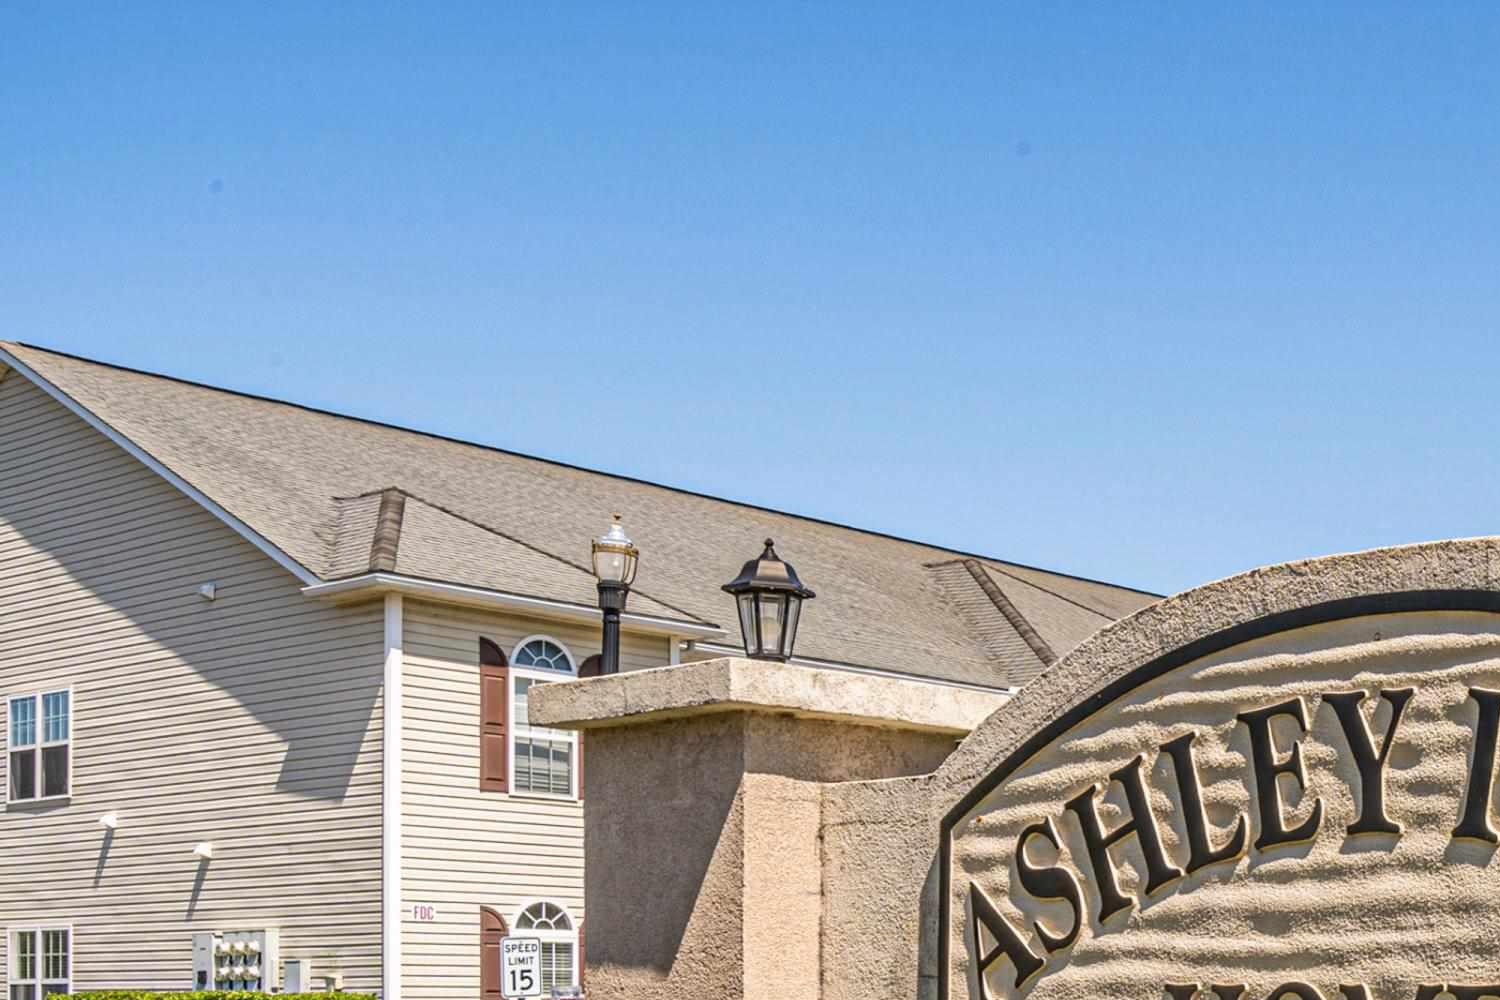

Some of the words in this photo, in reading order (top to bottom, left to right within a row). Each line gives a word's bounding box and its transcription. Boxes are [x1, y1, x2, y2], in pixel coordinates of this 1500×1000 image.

[413, 905, 434, 920] FDC
[504, 943, 538, 953] SPEED
[508, 956, 534, 966] LIMIT
[510, 969, 534, 991] 15
